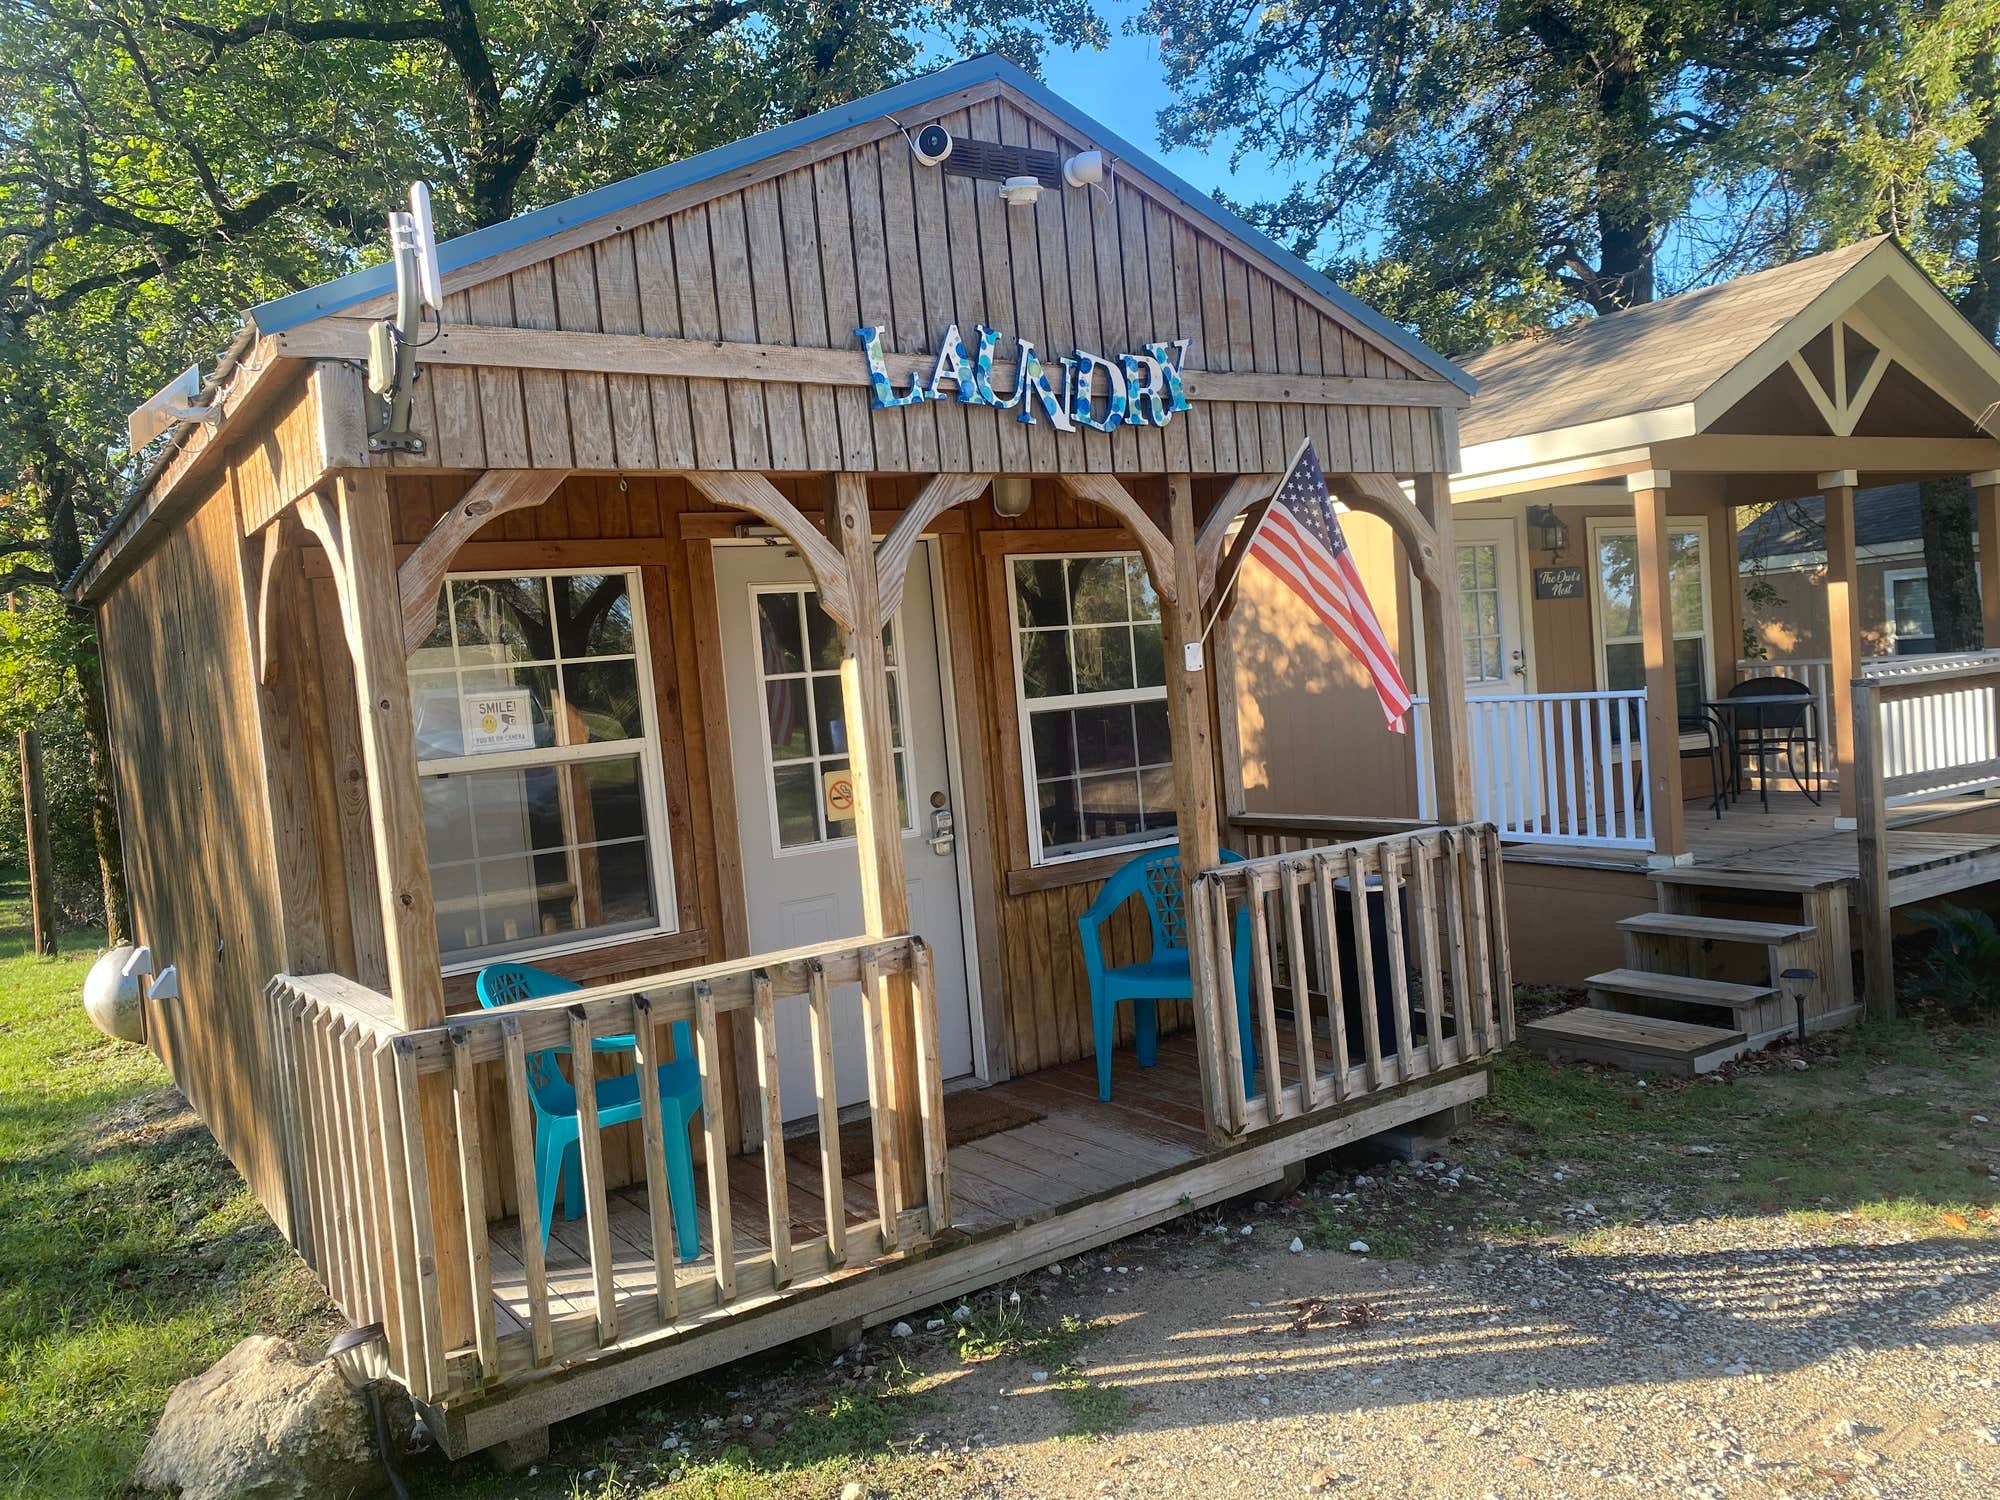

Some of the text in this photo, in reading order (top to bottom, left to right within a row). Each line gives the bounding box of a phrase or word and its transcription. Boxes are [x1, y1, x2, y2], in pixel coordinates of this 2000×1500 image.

[853, 324, 1193, 433] LAUNDRY
[1540, 571, 1556, 584] The
[479, 701, 516, 714] SMILE!
[505, 733, 526, 741] CAMERA
